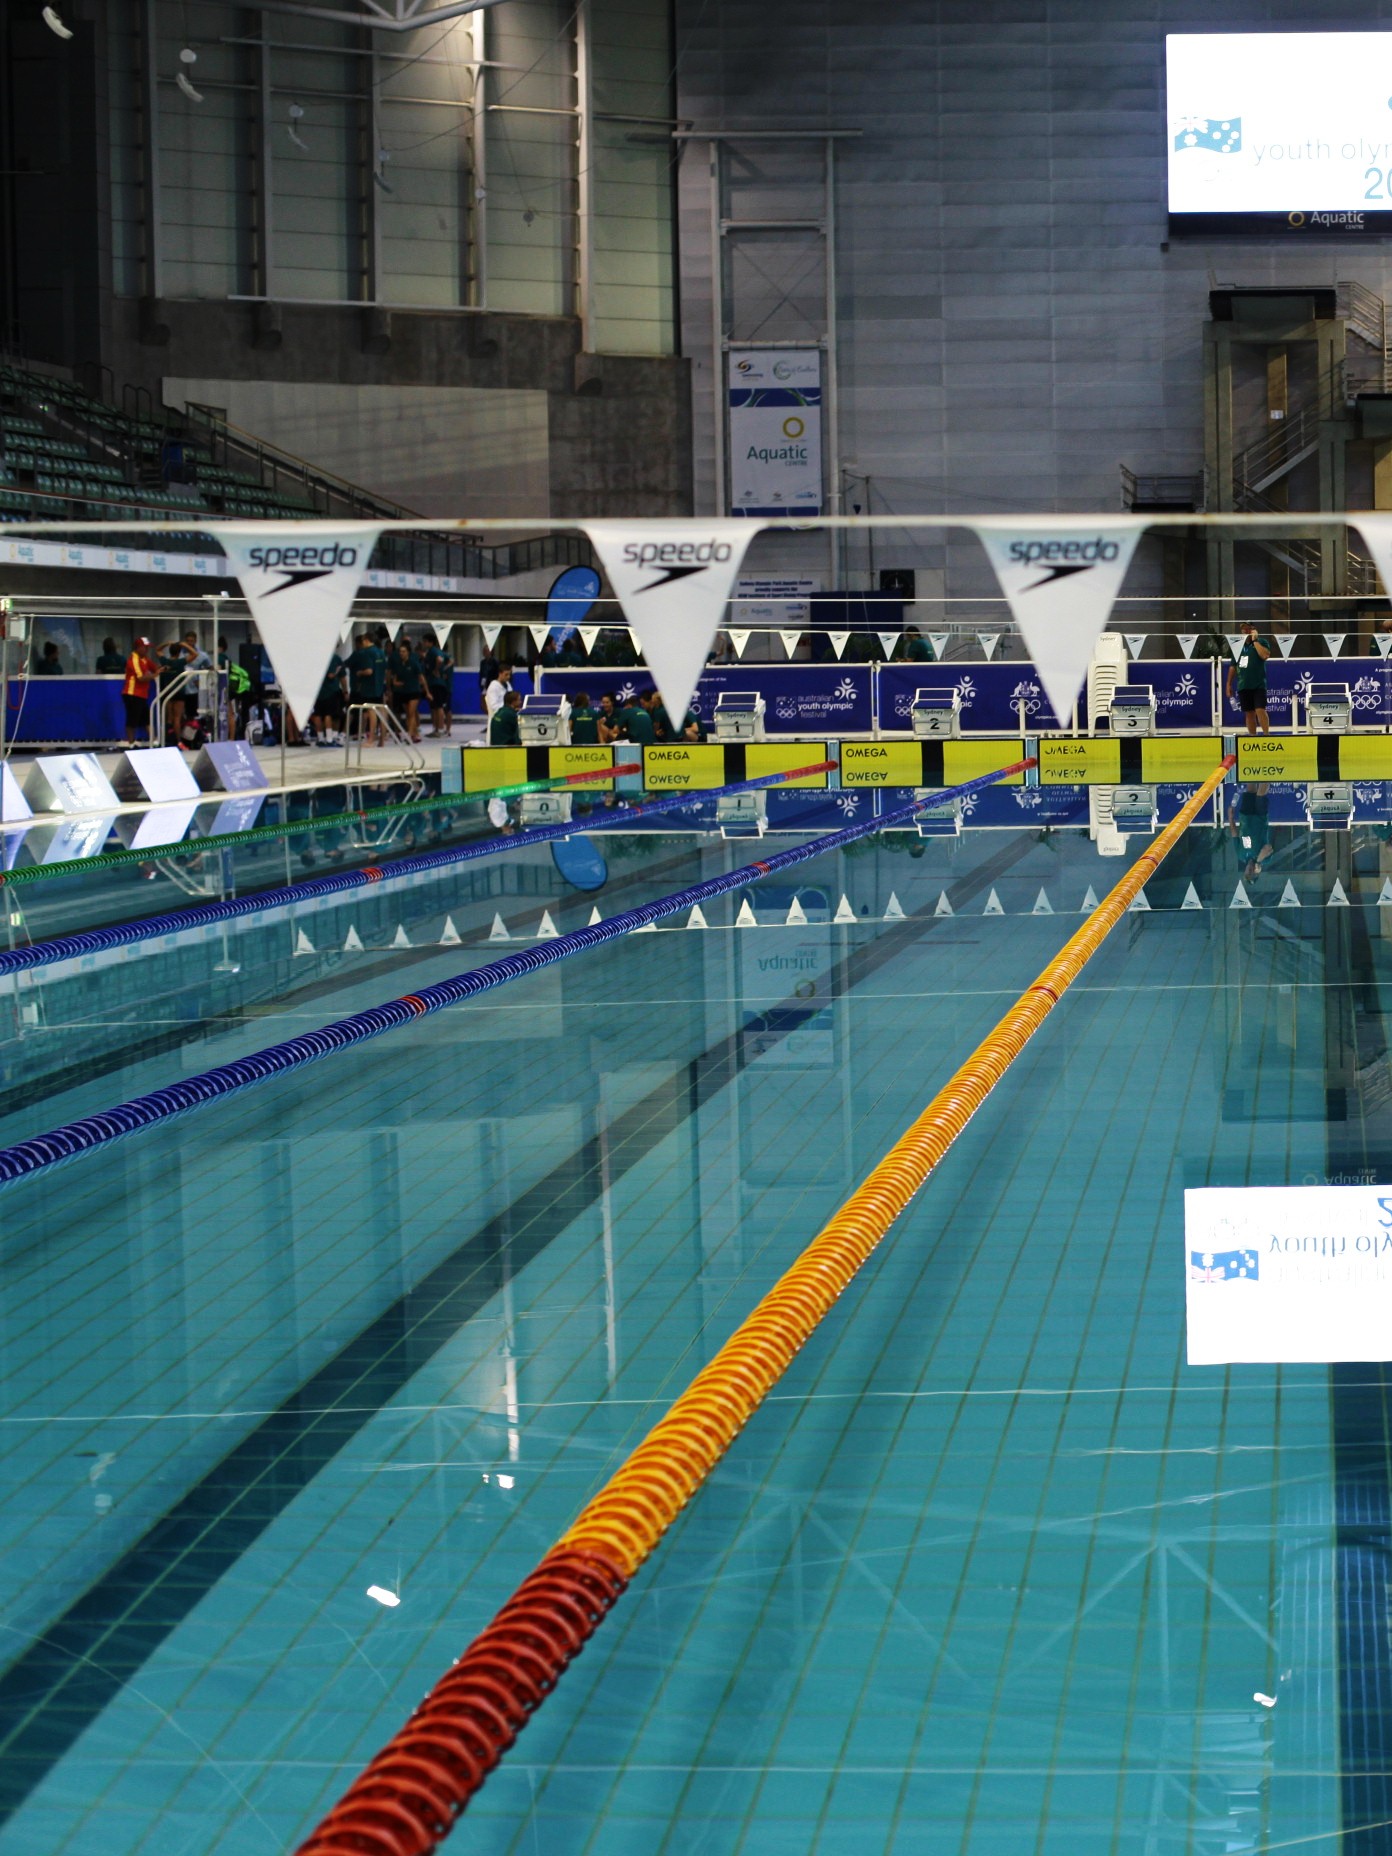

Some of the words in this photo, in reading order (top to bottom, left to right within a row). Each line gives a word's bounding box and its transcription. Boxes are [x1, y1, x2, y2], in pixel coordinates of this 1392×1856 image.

[1254, 138, 1330, 166] youth
[1311, 211, 1364, 226] Aquatic
[747, 445, 807, 464] Aquatic
[249, 542, 357, 572] speedo
[622, 538, 732, 569] speedo
[1010, 537, 1120, 566] speedo
[1266, 688, 1294, 696] stralian
[1162, 698, 1193, 707] olympic
[1267, 696, 1280, 704] uth
[798, 702, 820, 711] youth
[822, 702, 853, 710] olympic
[1265, 704, 1287, 712] estival
[930, 718, 940, 730] 2
[1128, 715, 1138, 727] 3
[1323, 712, 1333, 724] 4
[538, 723, 547, 736] 0
[734, 721, 739, 733] 1
[846, 748, 888, 757] OMEGA
[1243, 743, 1284, 752] OMEGA
[565, 753, 608, 763] OMEGA
[648, 751, 690, 761] OMEGA
